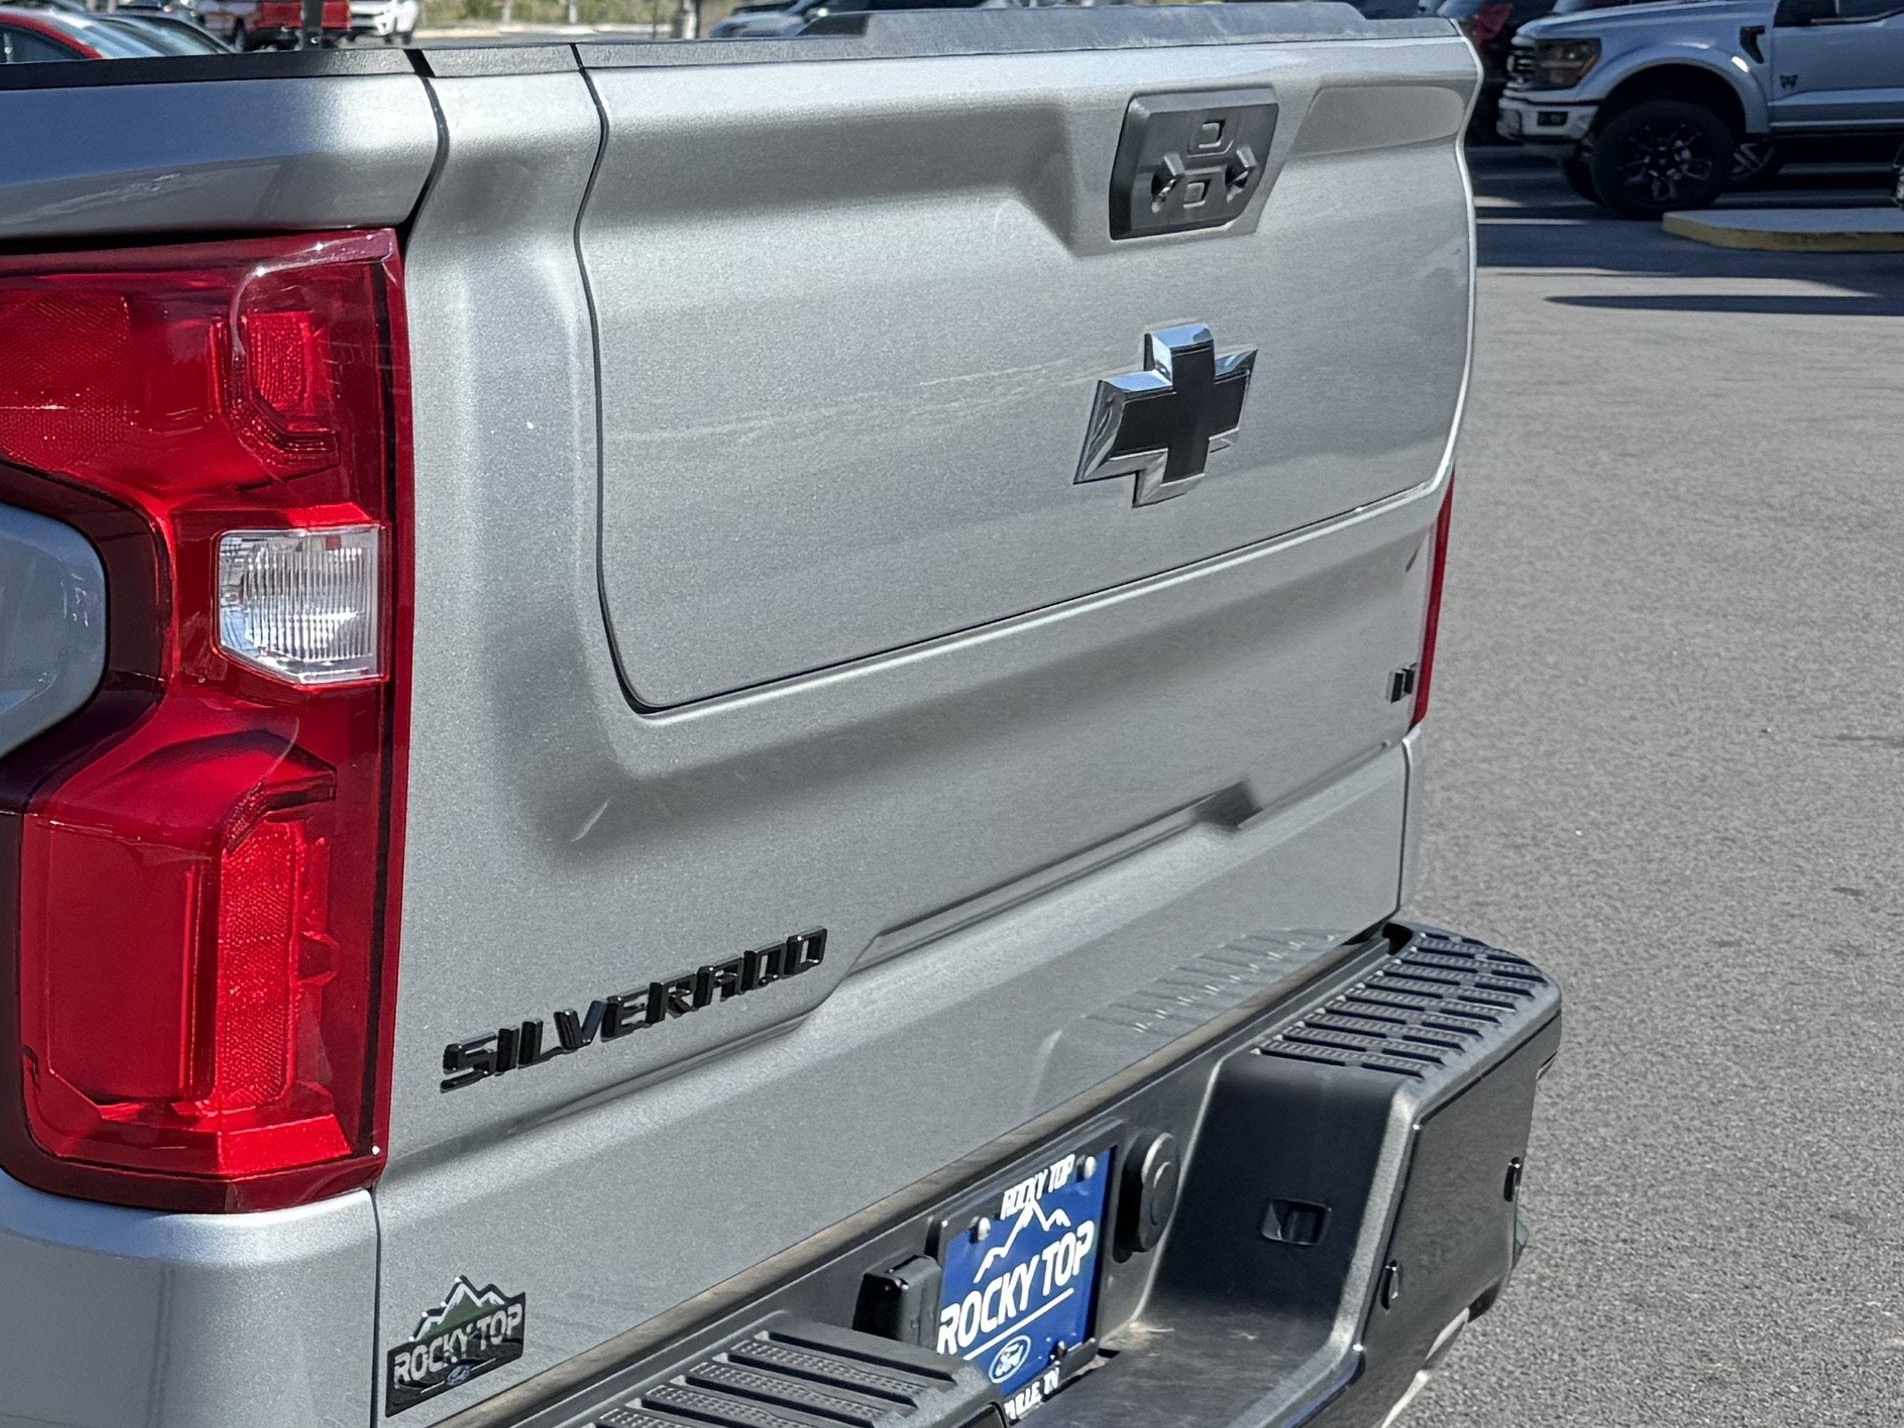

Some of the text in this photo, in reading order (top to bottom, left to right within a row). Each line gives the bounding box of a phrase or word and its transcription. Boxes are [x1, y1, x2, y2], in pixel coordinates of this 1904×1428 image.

[439, 925, 828, 1093] SILVERADO
[1048, 1154, 1075, 1193] TOP
[936, 1220, 1095, 1355] ROCKY TOP
[393, 1303, 524, 1390] ROCKY TOP
